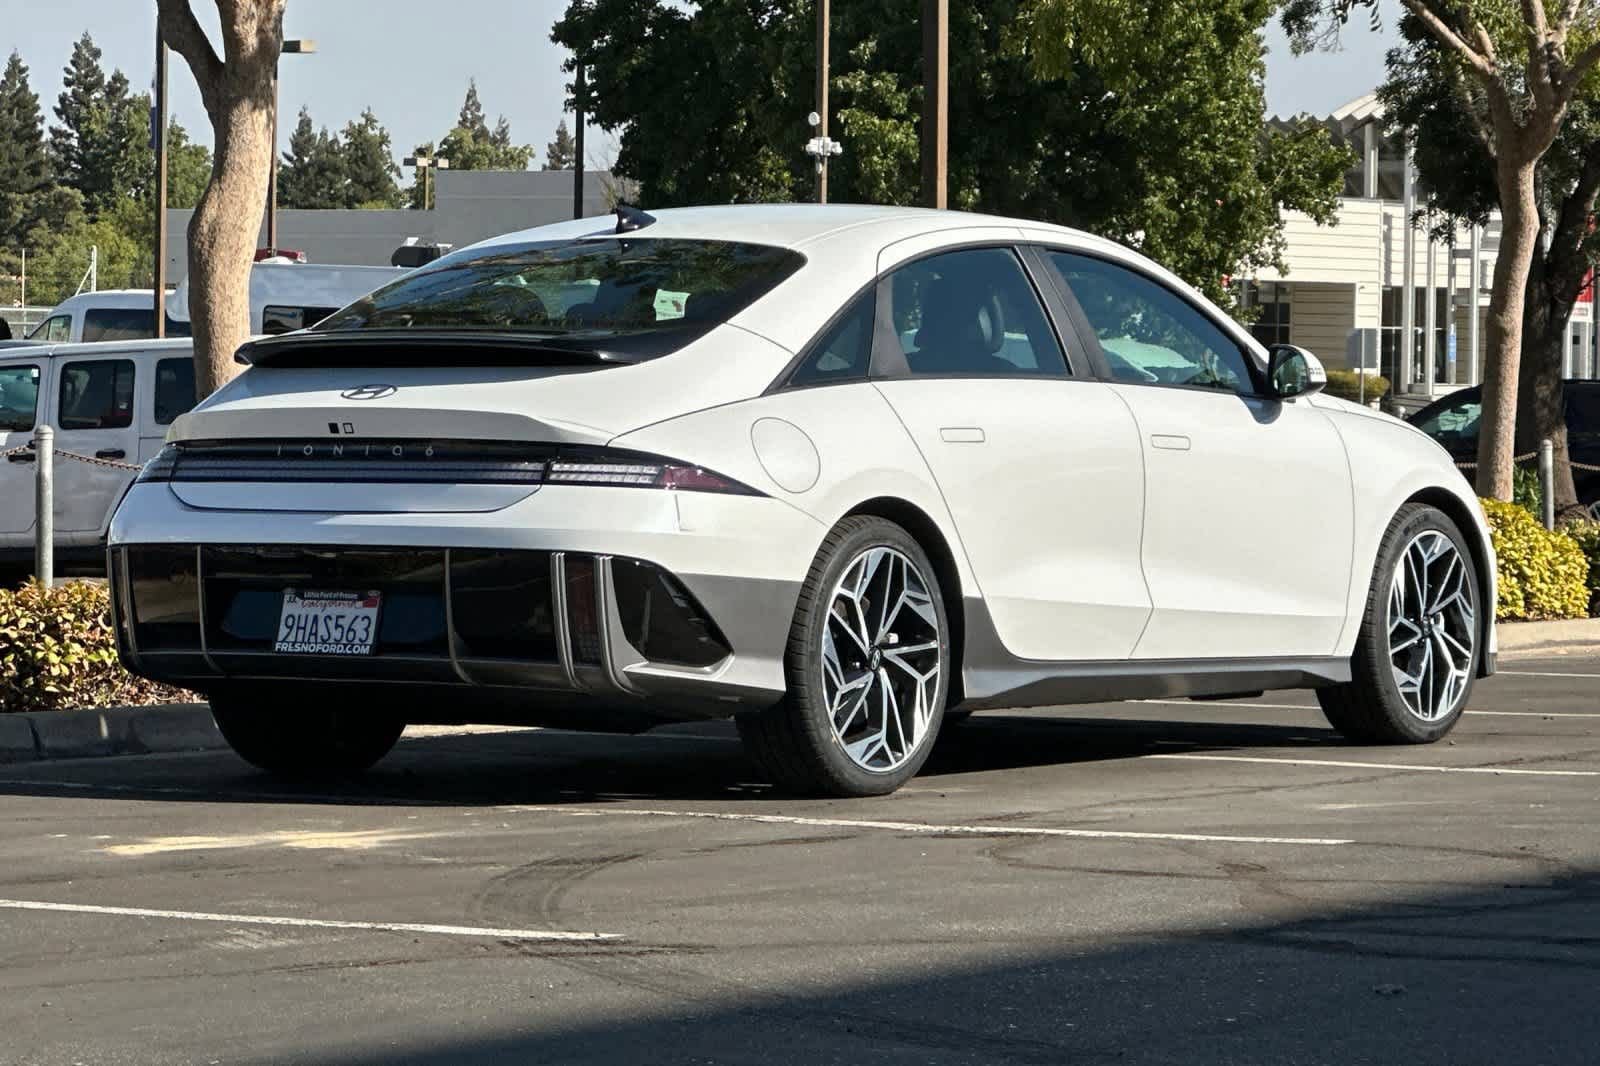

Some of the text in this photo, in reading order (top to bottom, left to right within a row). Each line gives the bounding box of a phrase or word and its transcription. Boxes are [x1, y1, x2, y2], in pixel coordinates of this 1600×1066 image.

[276, 445, 434, 456] IONIQ 6
[281, 614, 372, 644] 9HAS563
[275, 642, 370, 654] FRESNOFORD.COM
